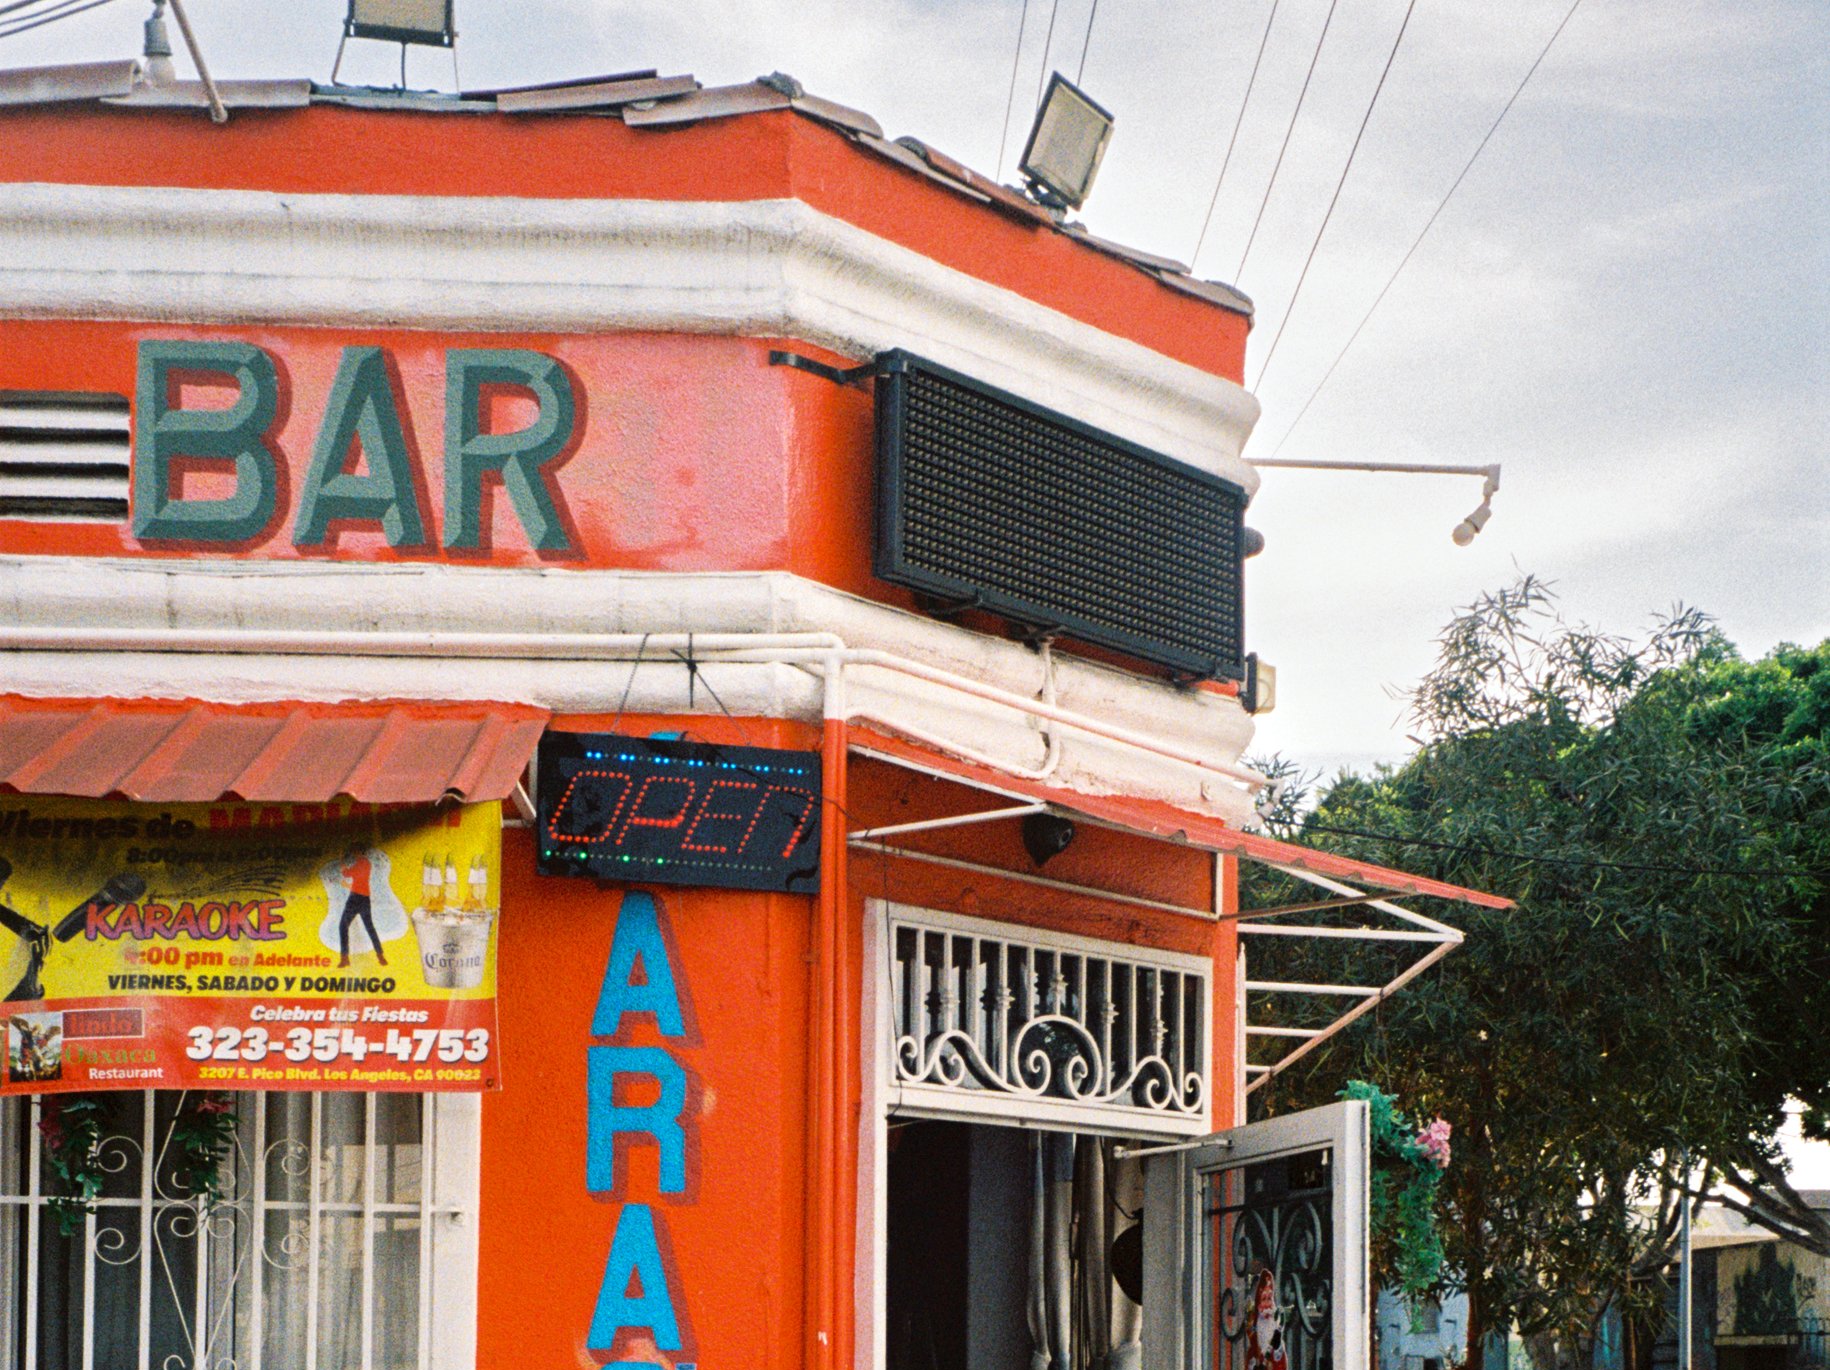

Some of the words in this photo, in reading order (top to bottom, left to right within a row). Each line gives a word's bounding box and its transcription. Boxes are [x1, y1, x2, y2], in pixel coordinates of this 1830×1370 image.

[132, 340, 586, 558] BAR
[84, 899, 288, 941] KARAOKE
[184, 950, 224, 970] pm
[253, 952, 331, 967] Adelante
[108, 973, 193, 994] VIERNES,
[197, 975, 279, 992] SABADO
[284, 976, 297, 992] Y
[300, 976, 396, 994] DOMINGO
[250, 1004, 327, 1022] Celebra
[328, 1006, 360, 1022] tus
[361, 1005, 430, 1023] Fiestas
[65, 1042, 157, 1065] Oaxaca
[186, 1025, 490, 1063] 323-354-4753
[88, 1067, 164, 1080] Restaurant
[199, 1066, 236, 1080] 3207
[237, 1067, 249, 1080] E.
[251, 1066, 284, 1080] Pico
[286, 1067, 322, 1081] Blvd.
[324, 1068, 348, 1081] Los
[350, 1068, 412, 1083] Angeles,
[413, 1068, 434, 1081] CA
